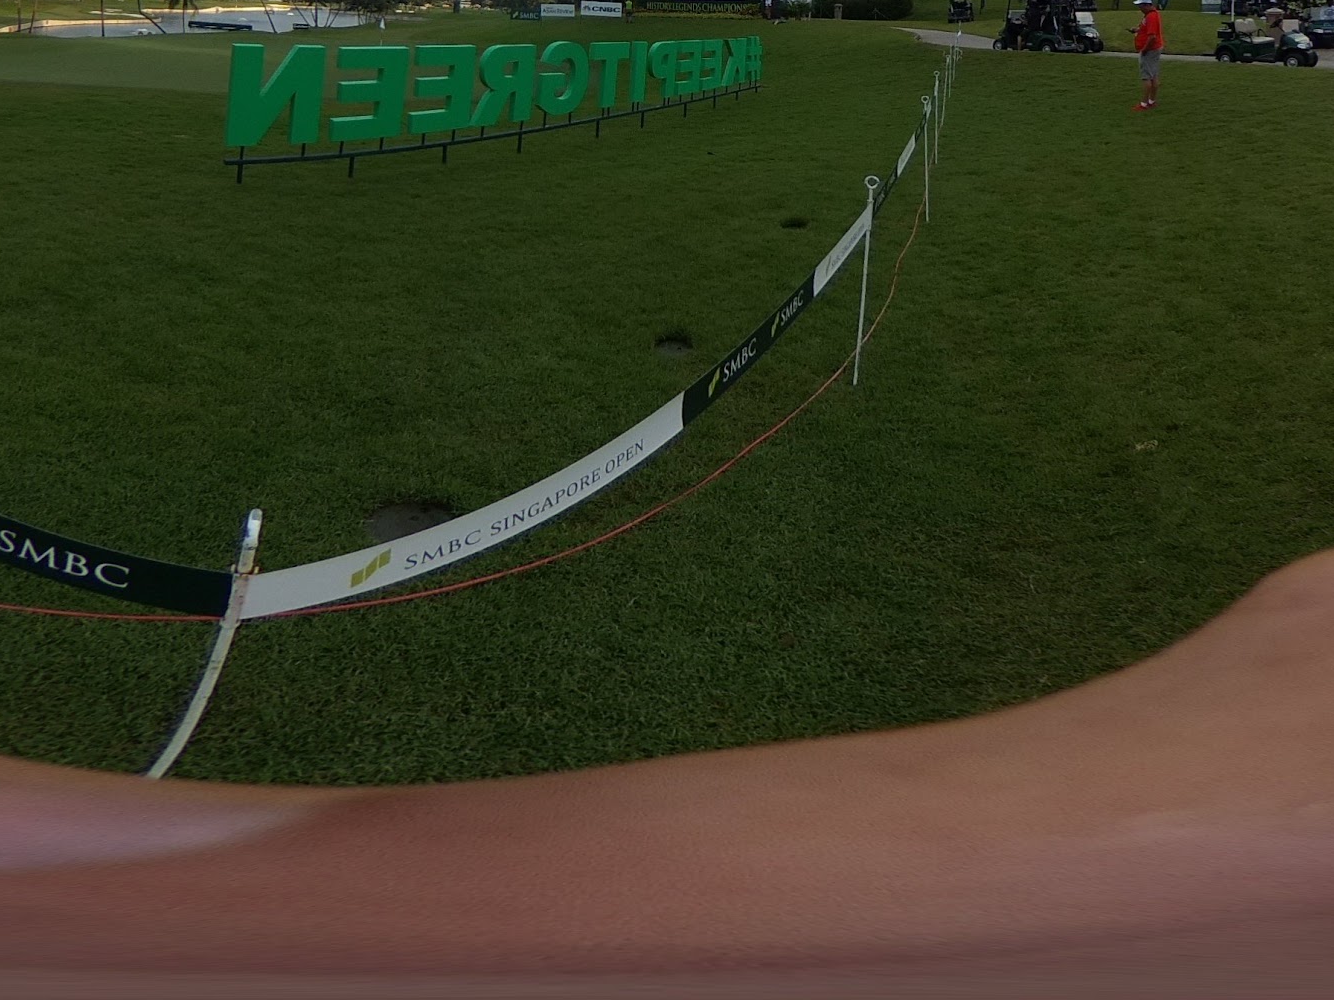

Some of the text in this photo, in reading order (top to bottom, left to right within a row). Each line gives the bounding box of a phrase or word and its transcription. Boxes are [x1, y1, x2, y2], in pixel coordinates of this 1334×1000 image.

[591, 5, 621, 13] CNBC
[780, 290, 804, 326] SMBC
[723, 337, 757, 382] SMBC
[404, 438, 646, 571] SMBC SINGAPORE OPEN
